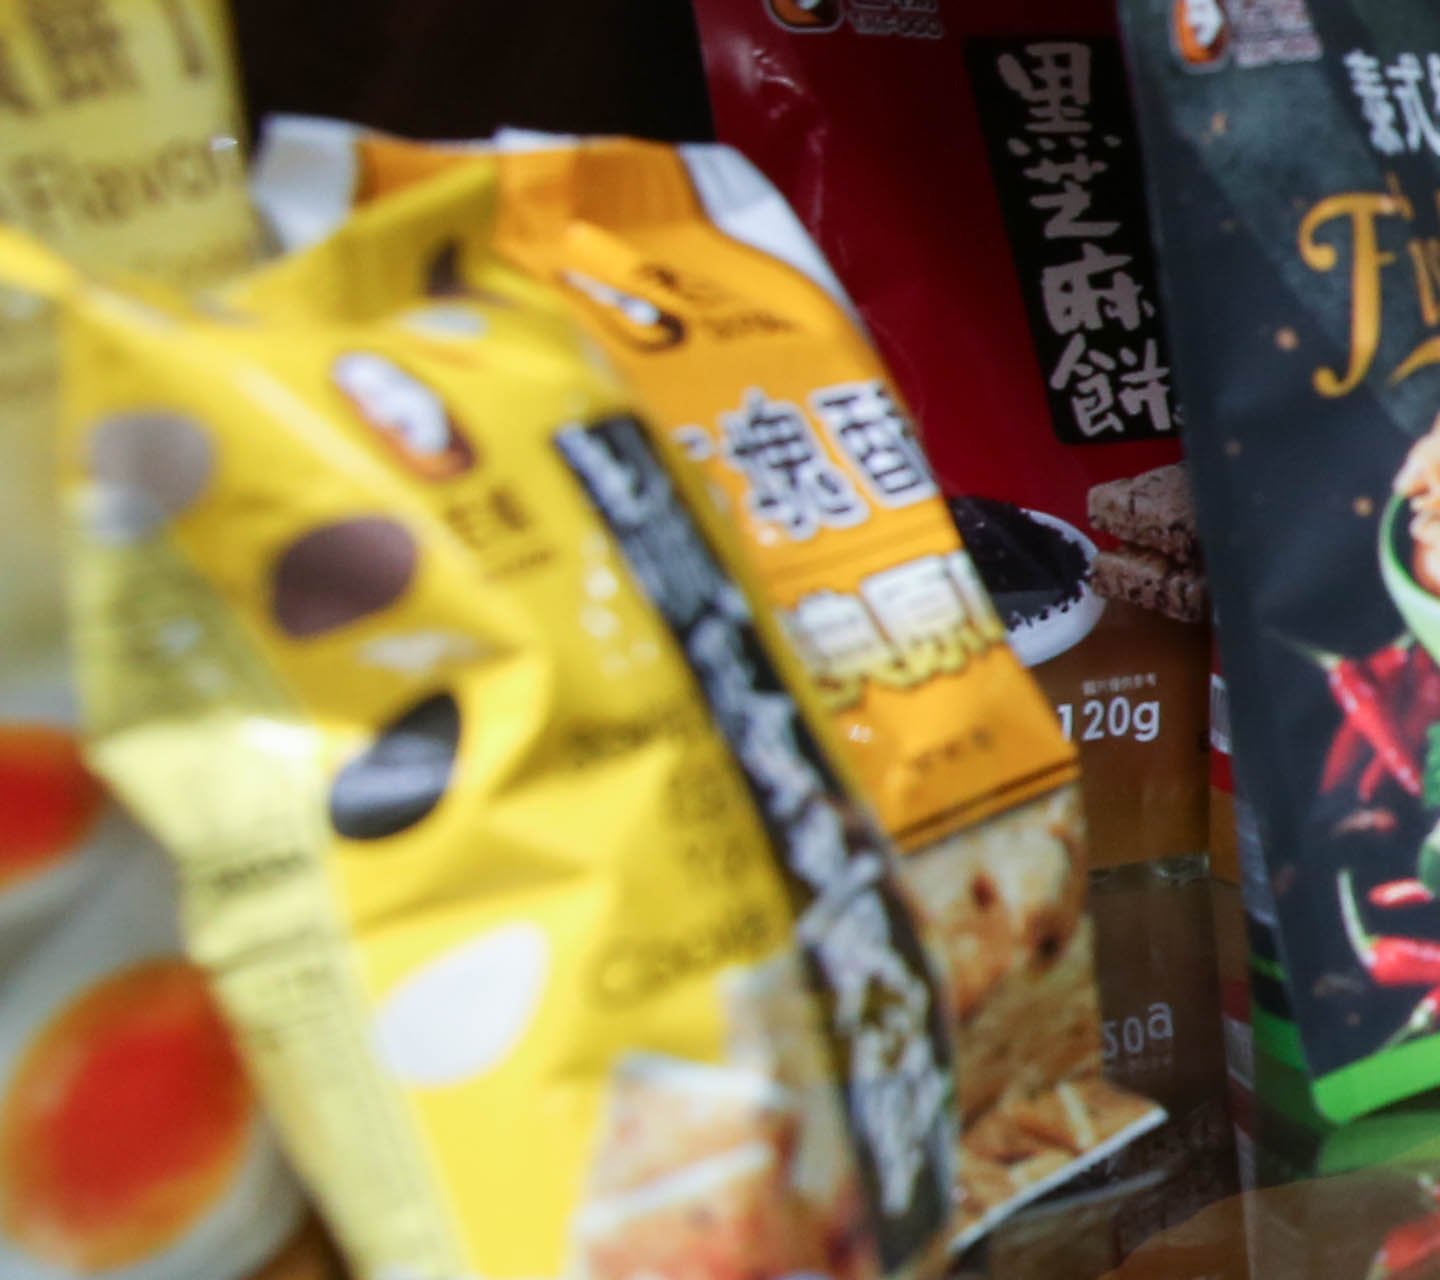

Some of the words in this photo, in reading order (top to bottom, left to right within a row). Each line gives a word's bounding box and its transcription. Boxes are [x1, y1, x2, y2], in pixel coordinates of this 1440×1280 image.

[999, 41, 1184, 439] 黑芝麻餅
[1056, 696, 1161, 743] 120g
